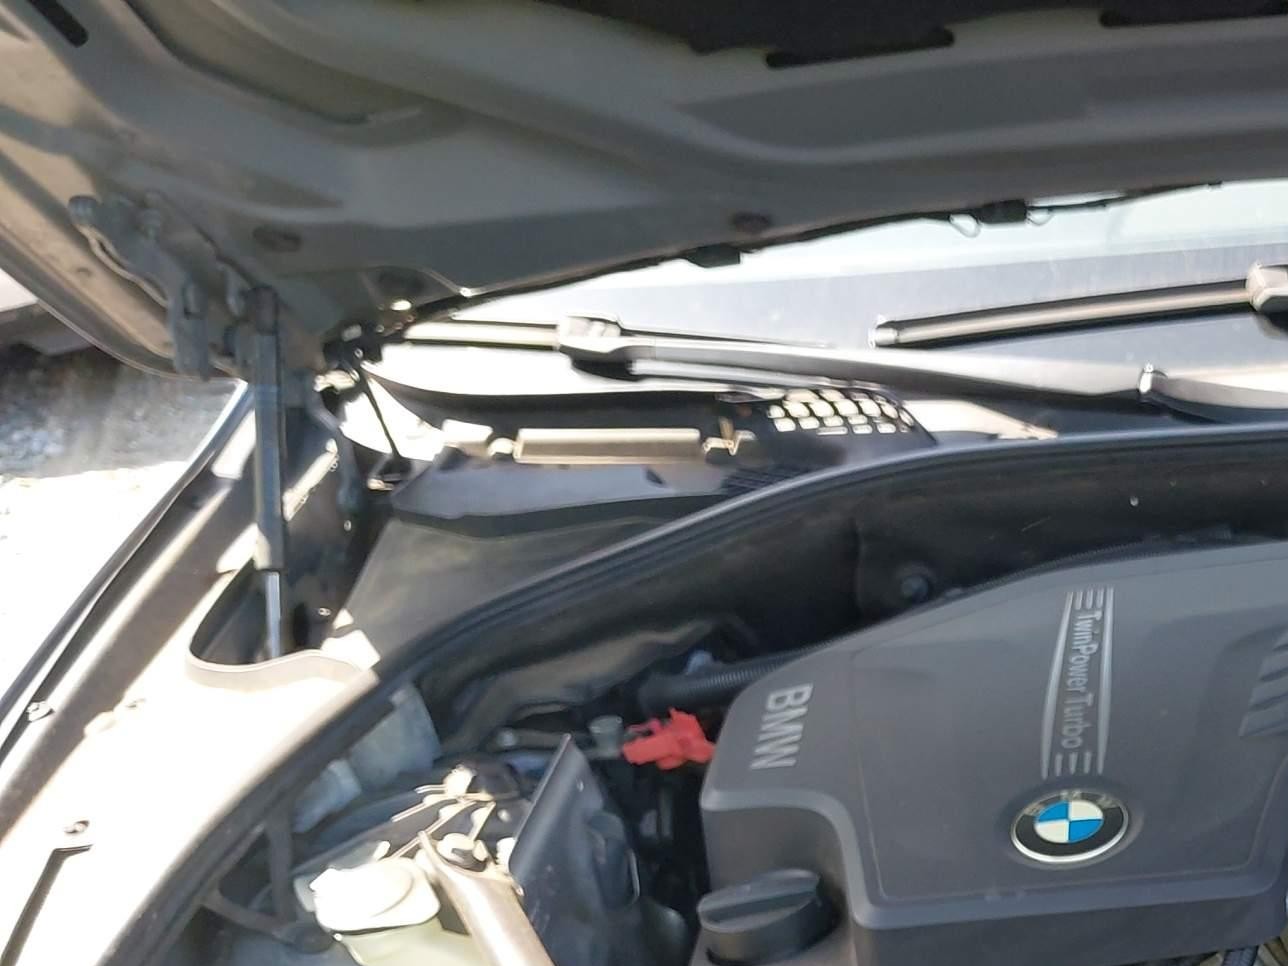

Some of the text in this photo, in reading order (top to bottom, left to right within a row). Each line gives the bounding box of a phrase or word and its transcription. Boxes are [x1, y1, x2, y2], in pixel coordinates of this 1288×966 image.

[751, 683, 813, 769] BMW
[1061, 611, 1102, 748] TwinPower Turbo
